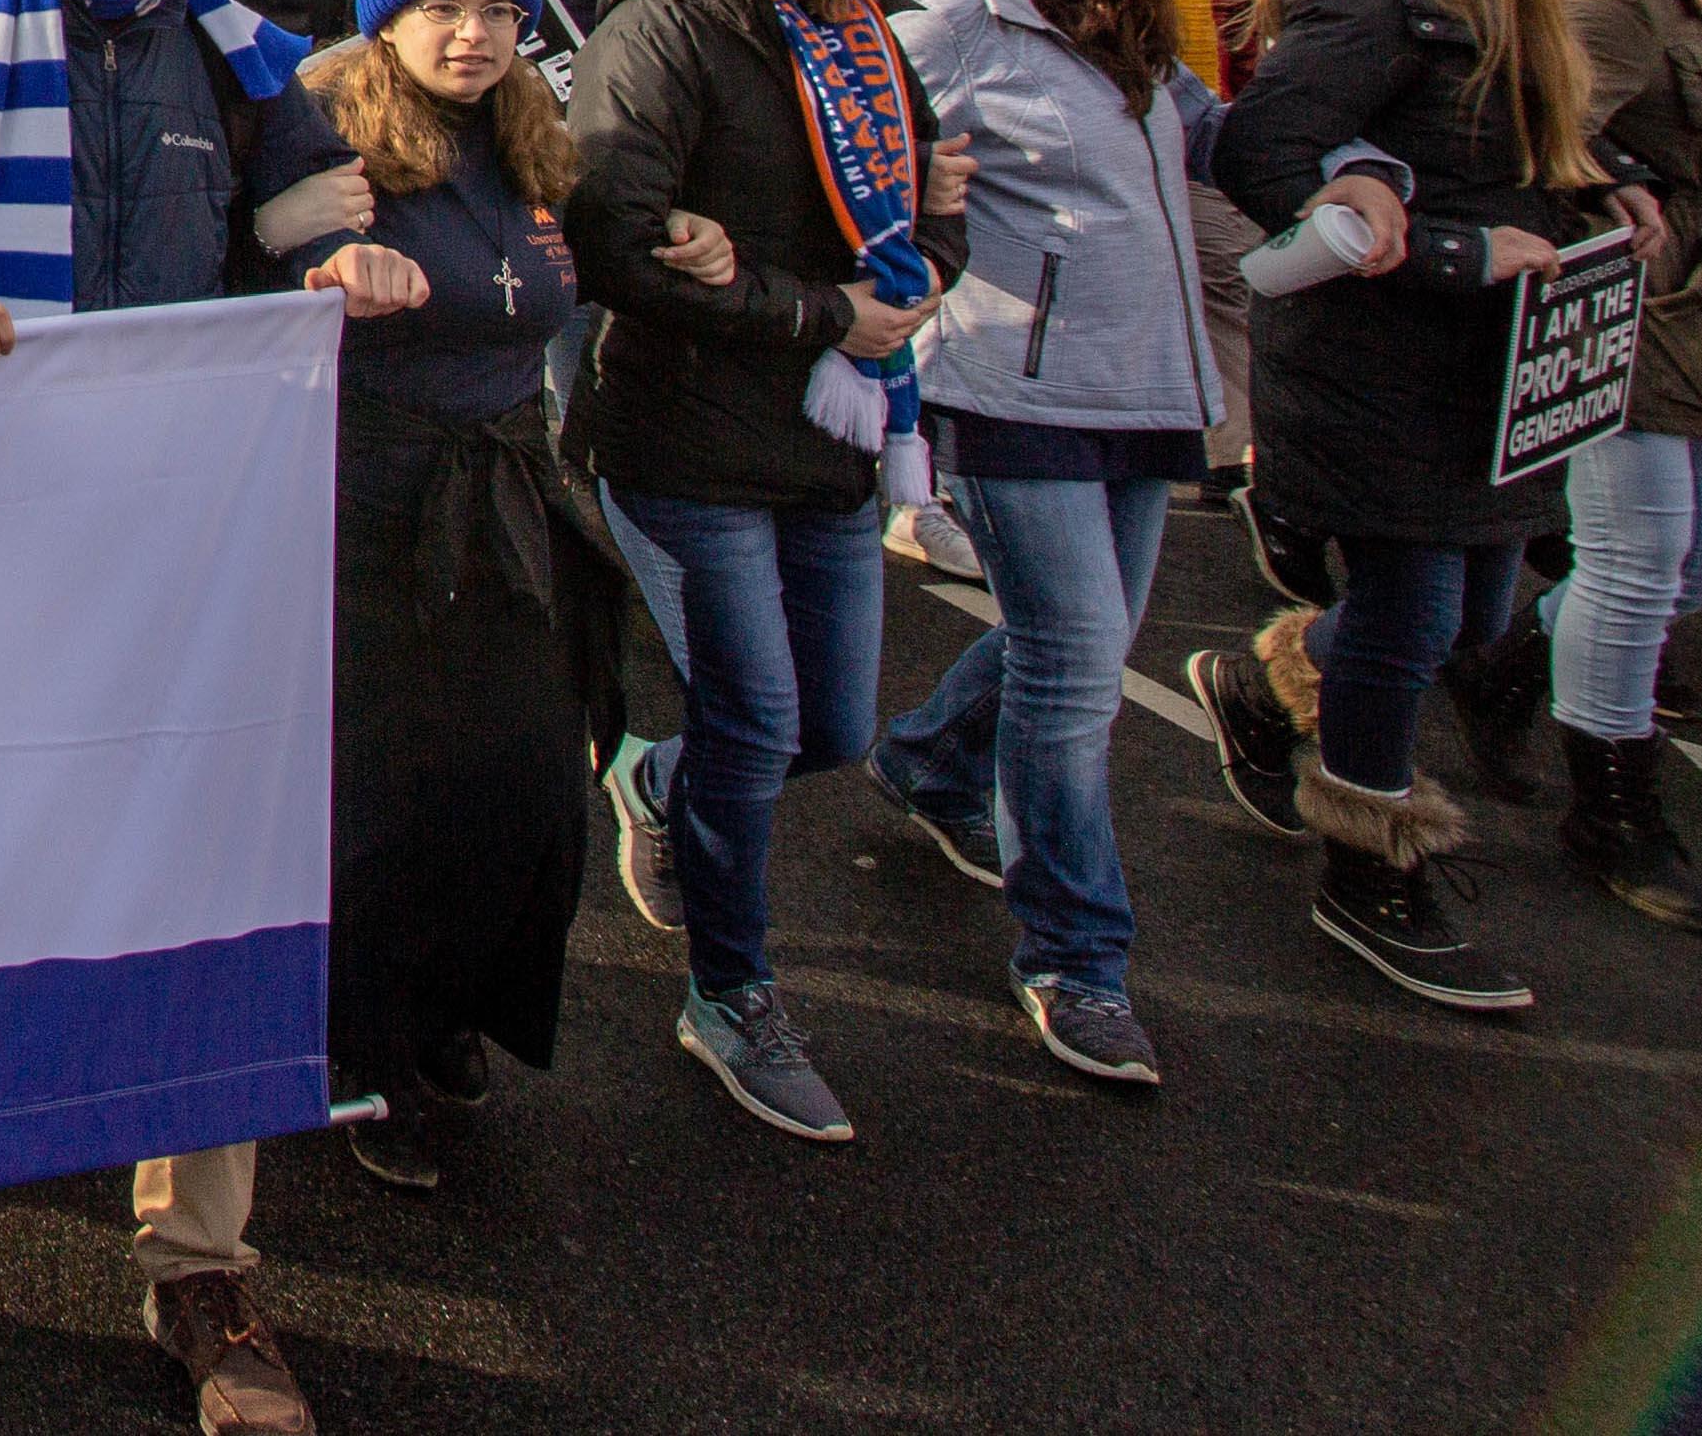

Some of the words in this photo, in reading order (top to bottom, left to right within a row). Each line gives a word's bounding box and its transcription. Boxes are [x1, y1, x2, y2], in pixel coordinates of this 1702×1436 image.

[1526, 315, 1538, 350] I
[1543, 298, 1586, 344] AM
[1591, 278, 1635, 324] THE
[1511, 319, 1636, 411] PRO-LIFE
[1508, 377, 1625, 458] GENERATION
